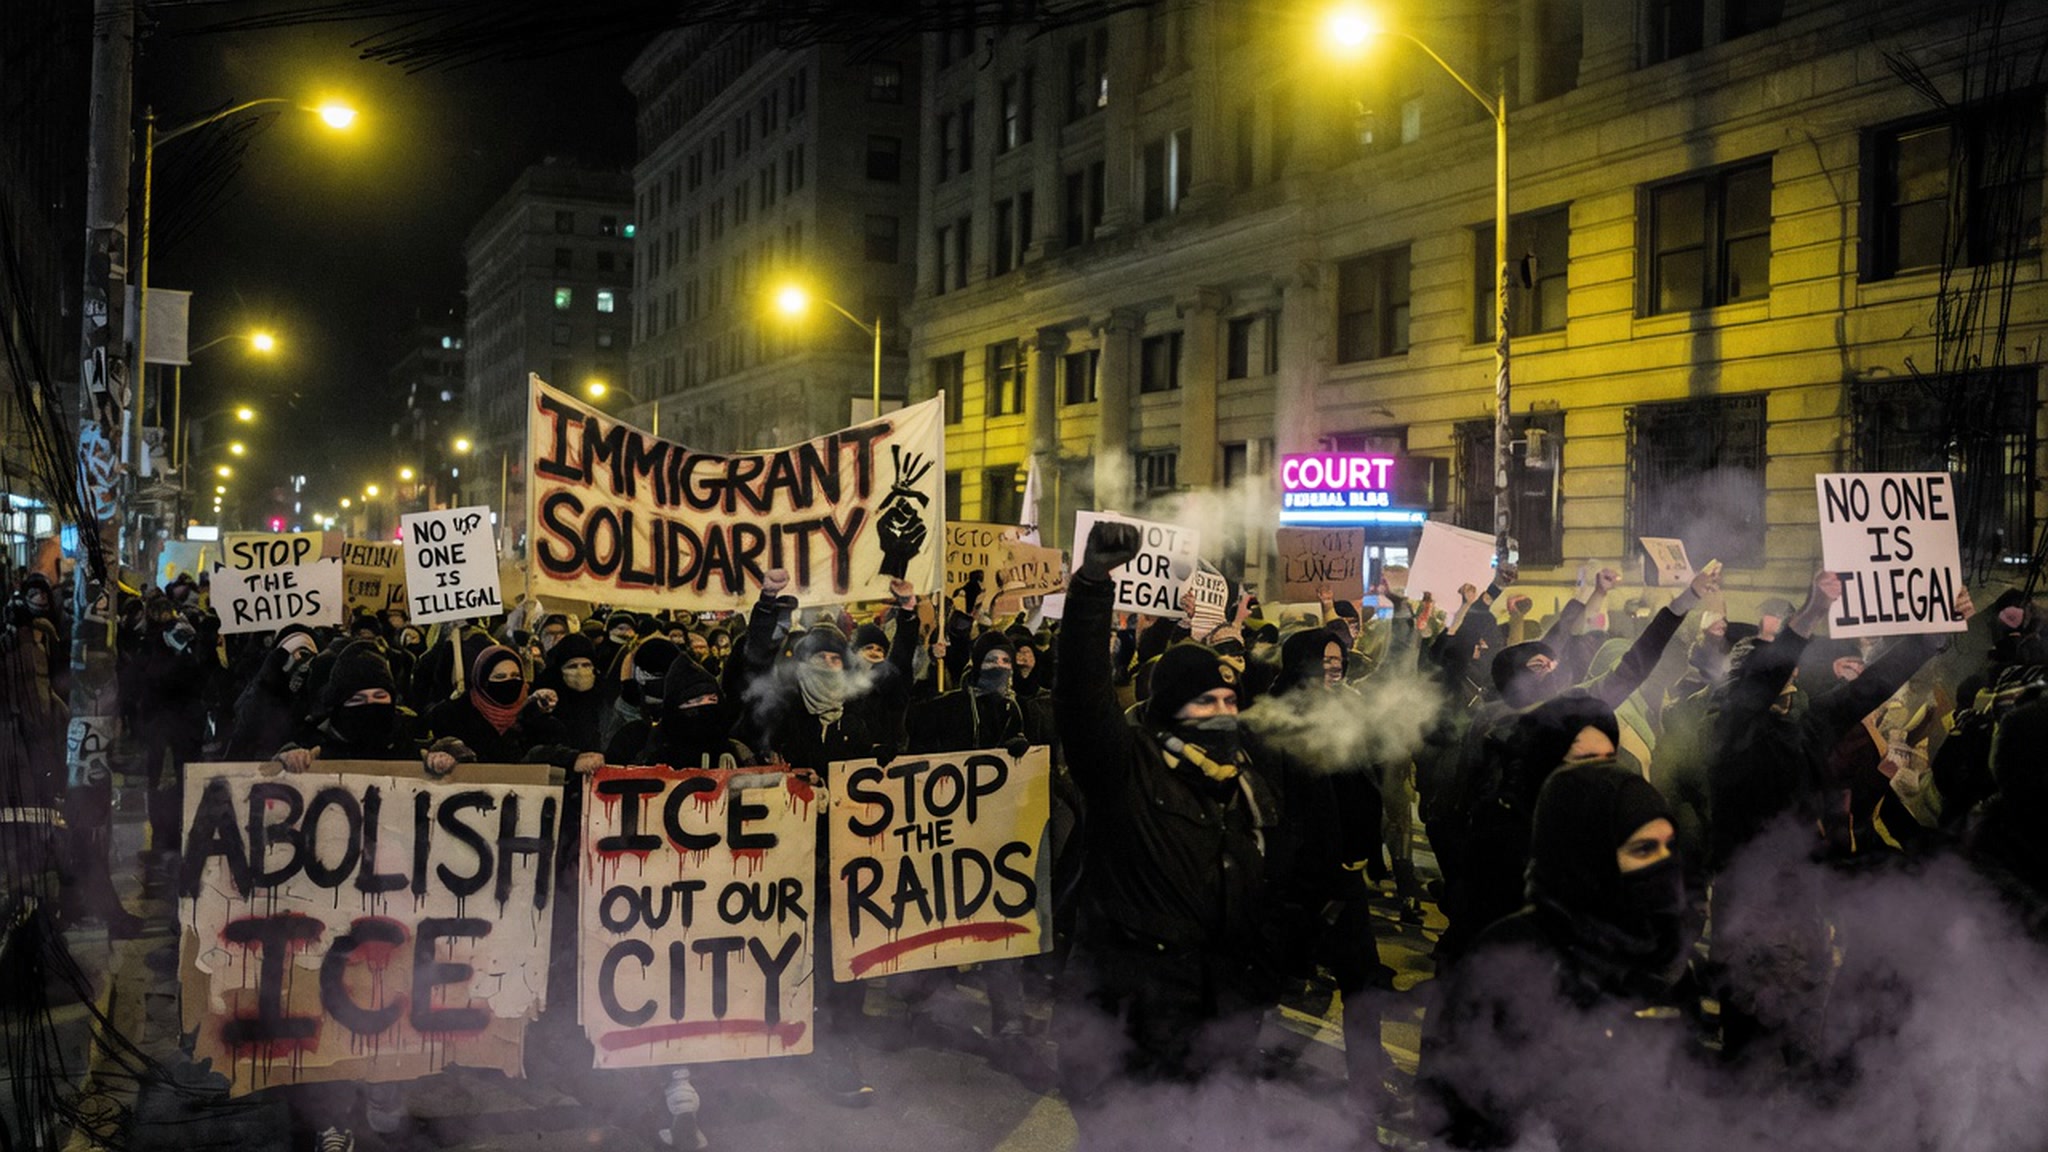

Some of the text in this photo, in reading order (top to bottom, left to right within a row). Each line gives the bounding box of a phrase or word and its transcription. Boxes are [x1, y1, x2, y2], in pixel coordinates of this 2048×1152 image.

[536, 393, 893, 516] IMMIGRANT
[1283, 457, 1394, 489] COURT
[1824, 475, 1949, 523] NO ONE
[413, 520, 446, 544] NO
[537, 490, 868, 597] SOLIDARITY
[1866, 525, 1914, 562] IS
[232, 538, 311, 570] STOP
[418, 543, 467, 568] ONE
[243, 571, 298, 593] THE
[435, 570, 461, 588] IS
[1118, 580, 1184, 612] EGAL
[1836, 568, 1966, 626] ILLEGAL
[232, 590, 321, 625] RAIDS
[415, 586, 501, 616] ILLEGAL
[597, 773, 780, 852] ICE
[846, 755, 1009, 837] STOP
[180, 776, 558, 909] ABOLISH
[894, 820, 954, 853] THE
[599, 877, 807, 932] OUT OUR
[840, 842, 1037, 938] RAIDS
[218, 914, 494, 1052] ICE
[599, 932, 802, 1028] CITY
